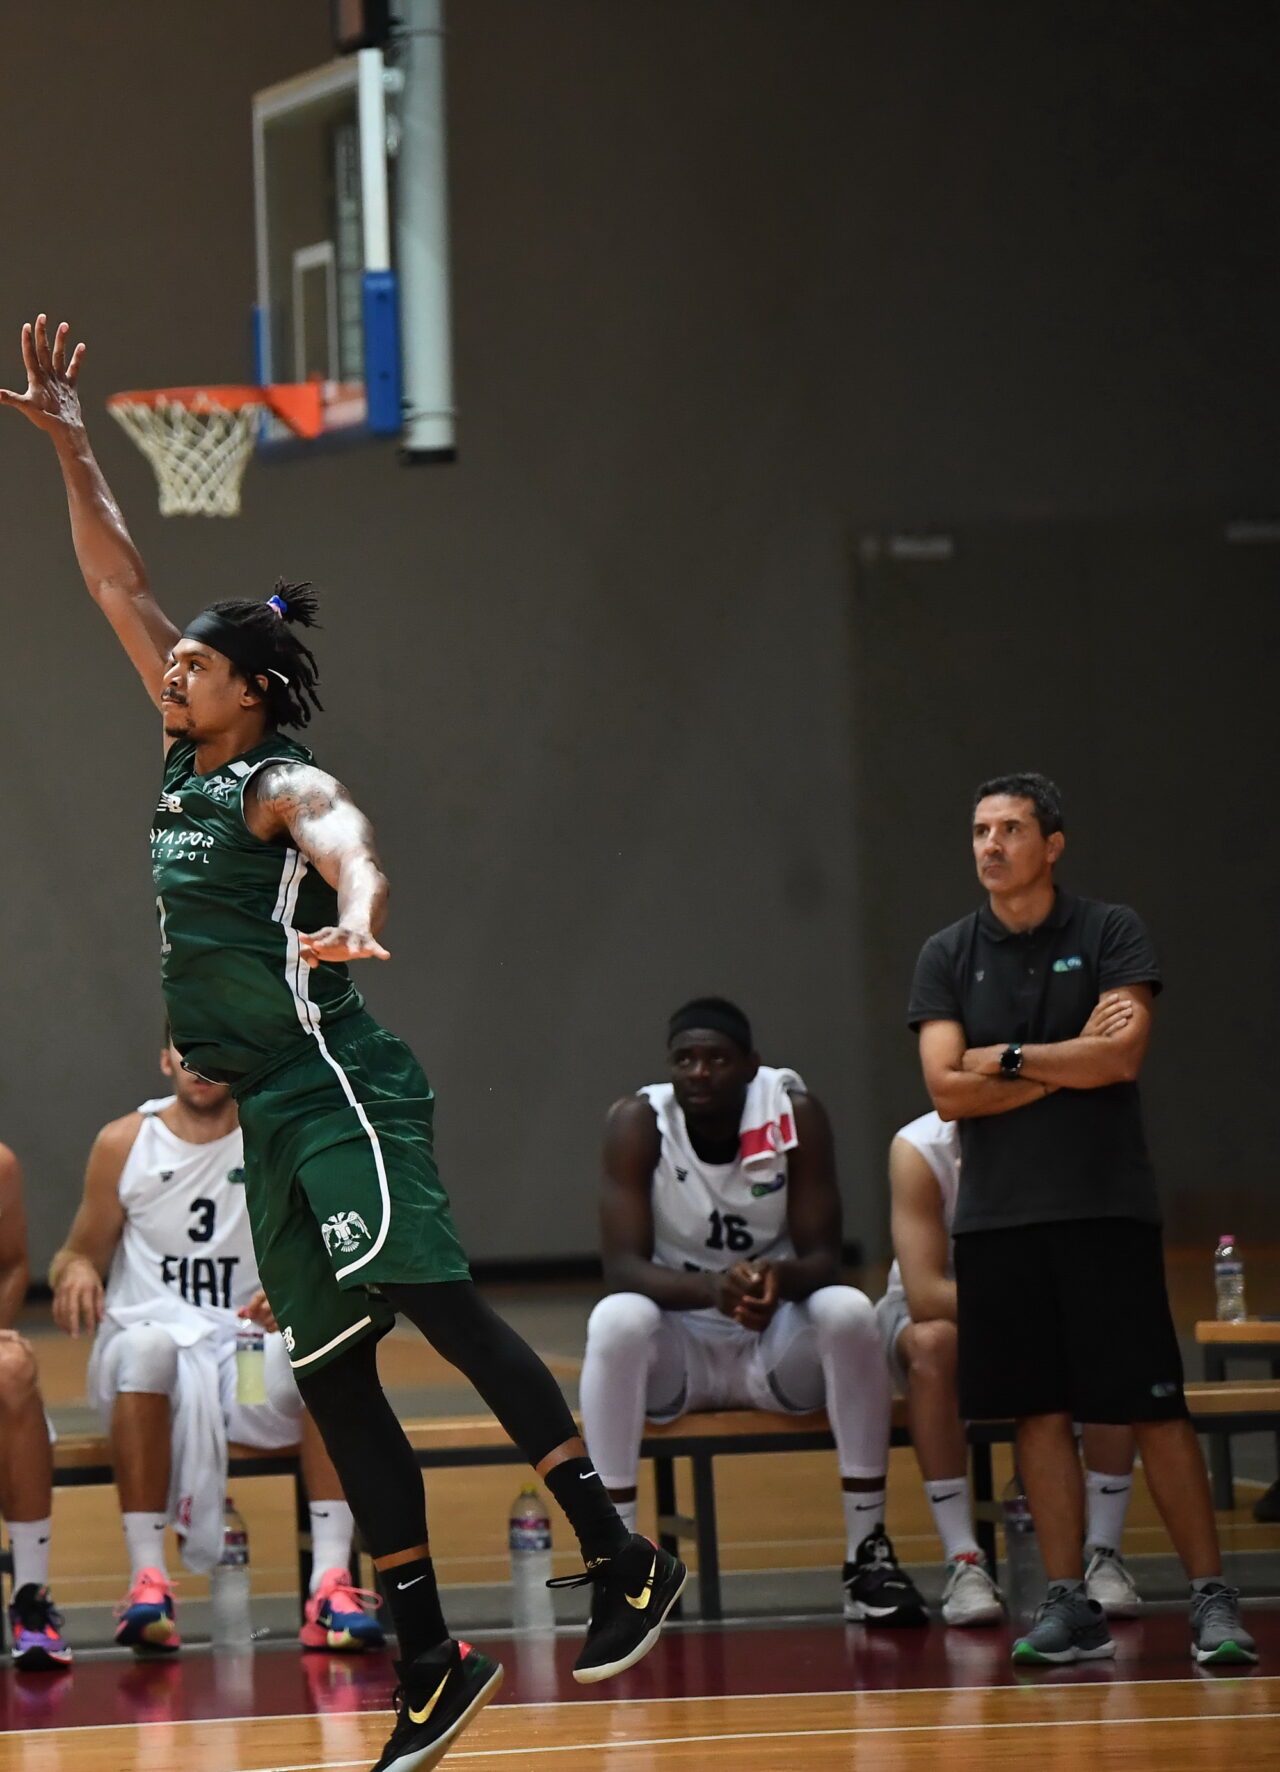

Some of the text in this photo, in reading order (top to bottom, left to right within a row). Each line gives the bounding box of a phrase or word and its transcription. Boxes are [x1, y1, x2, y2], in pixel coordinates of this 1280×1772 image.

[188, 1198, 215, 1243] 3
[706, 1209, 753, 1251] 16
[161, 1255, 239, 1308] FIAT
